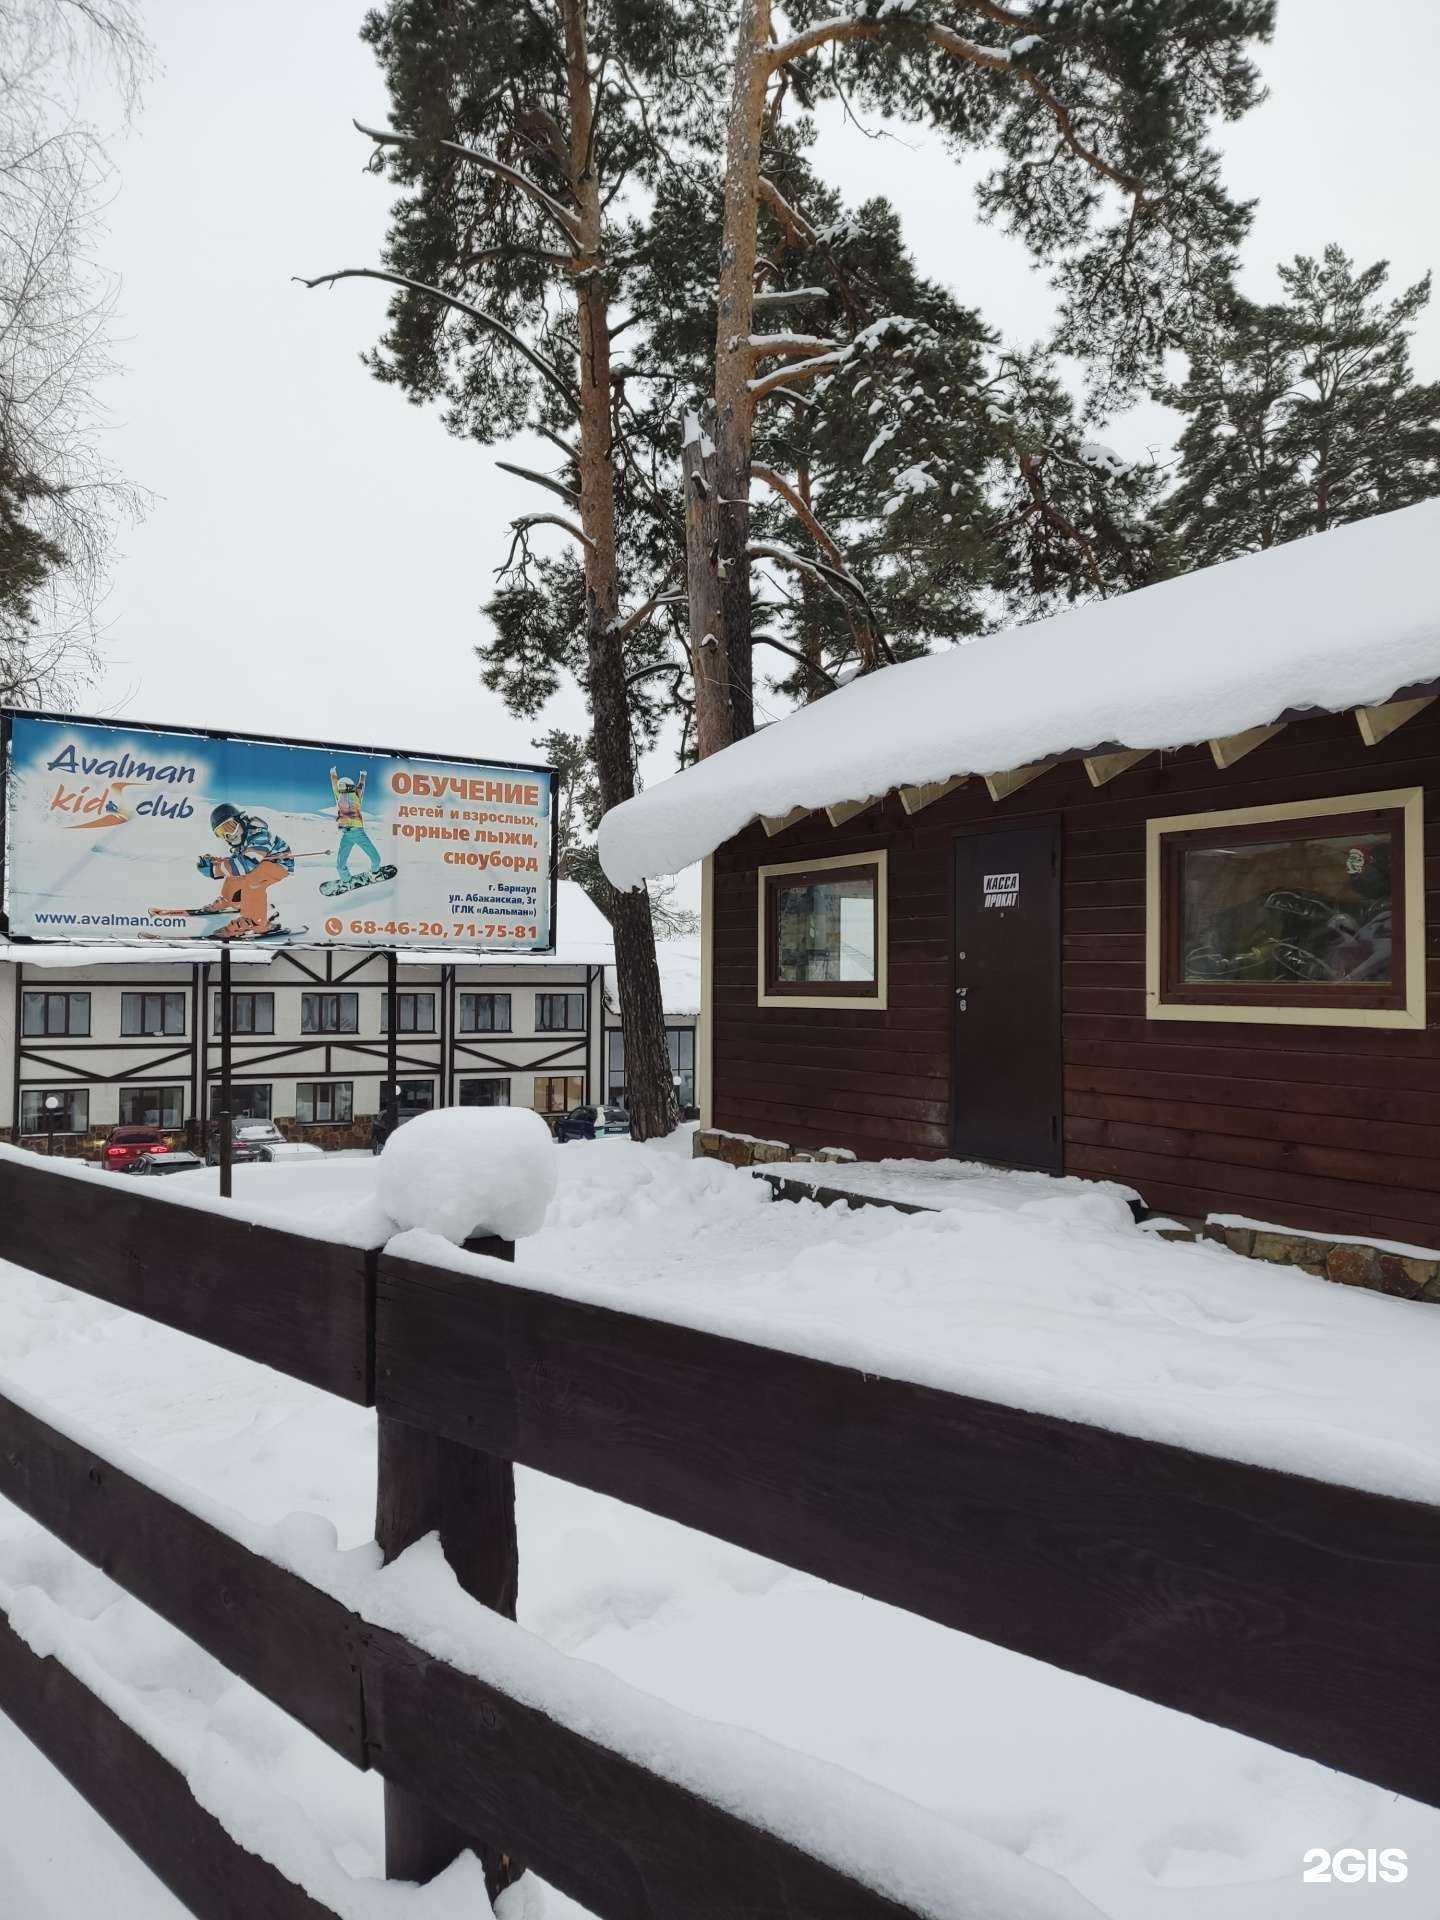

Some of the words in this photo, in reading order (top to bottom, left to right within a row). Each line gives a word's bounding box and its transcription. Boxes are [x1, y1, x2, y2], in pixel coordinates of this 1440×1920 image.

[47, 744, 196, 784] Avalman
[391, 771, 539, 806] ОБУЧЕНИЕ
[135, 794, 195, 820] club
[398, 804, 444, 819] детей
[450, 810, 459, 820] и
[463, 812, 539, 828] взрослых,
[392, 823, 470, 842] горные
[474, 830, 538, 848] лыжи,
[443, 850, 539, 873] сноуборд
[488, 884, 495, 892] г.
[498, 883, 537, 896] Барнаул
[986, 876, 1017, 890] КАССА
[448, 894, 464, 904] ул.
[466, 892, 525, 905] Абаканская,
[984, 893, 1018, 908] ПРОКАТ
[34, 911, 187, 929] www.avalman.com
[451, 905, 474, 915] (ГЛК
[476, 906, 537, 918] «Авальман»)
[350, 920, 448, 938] 68-46-20,
[453, 923, 537, 939] 71-75-81
